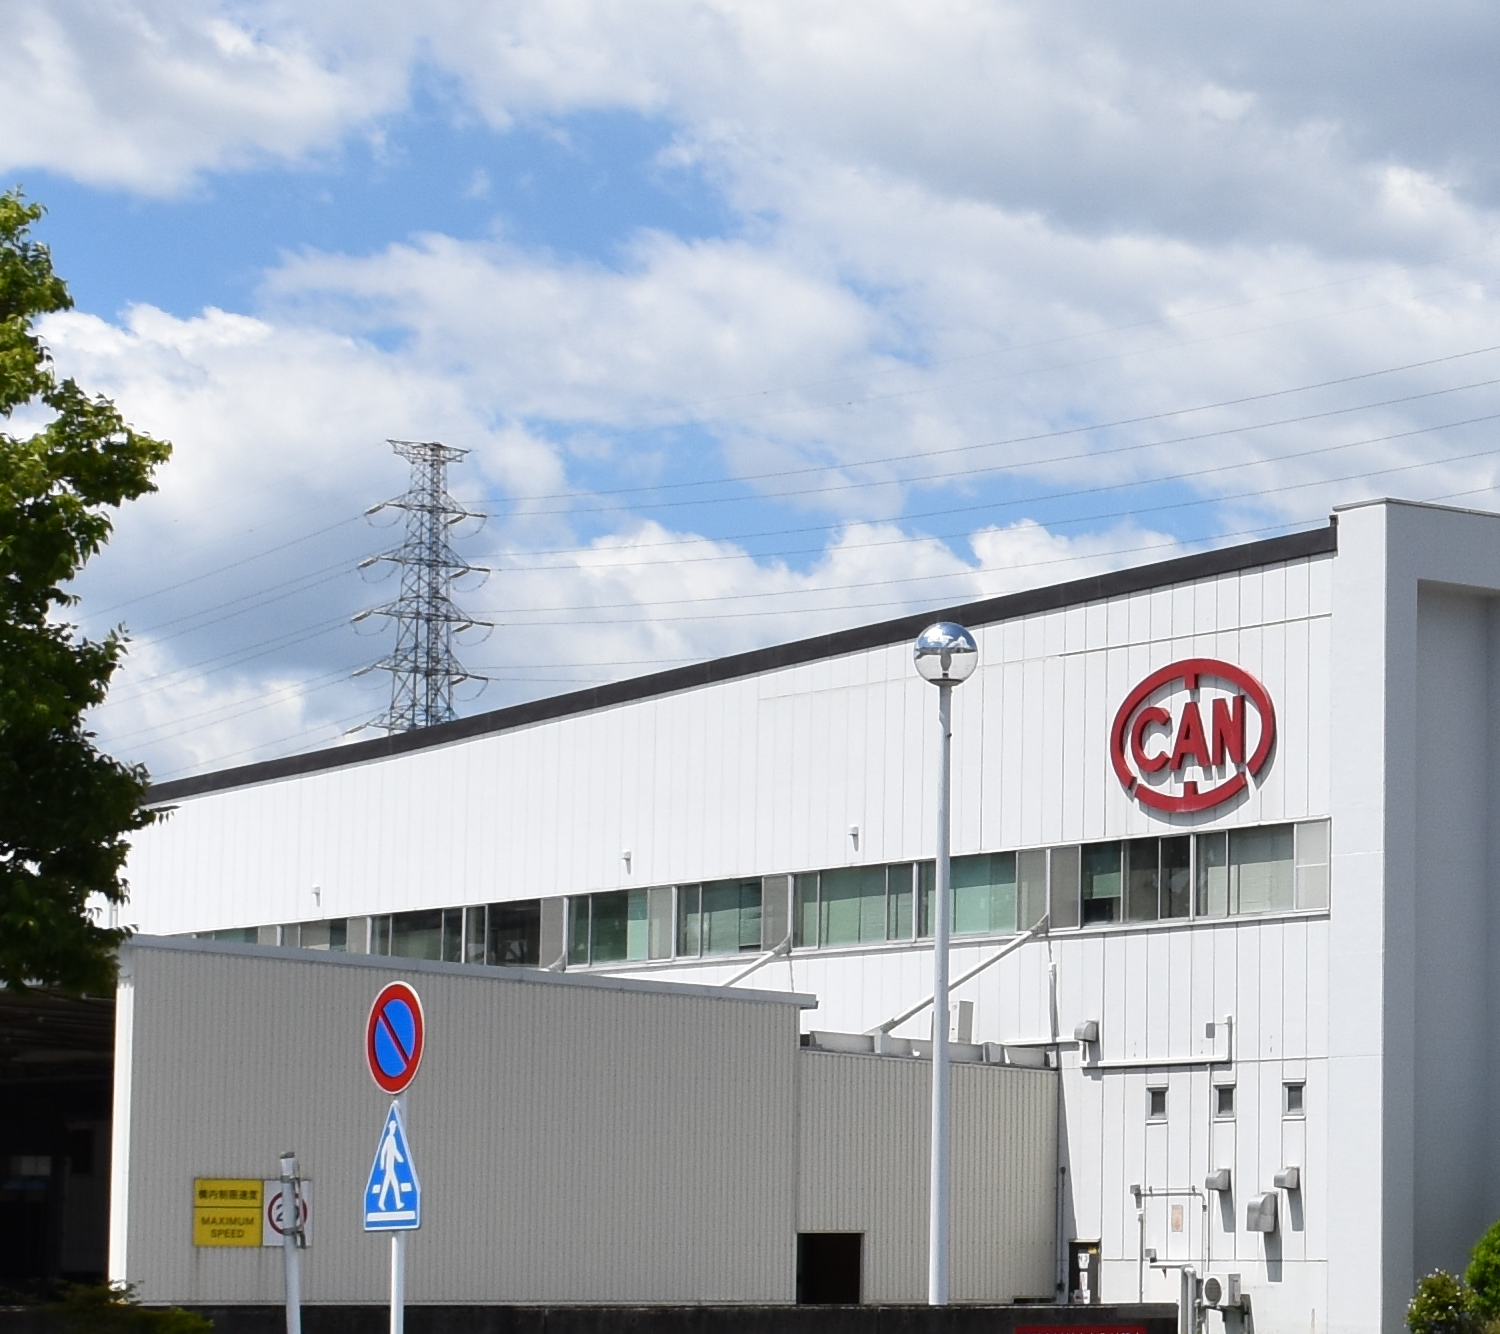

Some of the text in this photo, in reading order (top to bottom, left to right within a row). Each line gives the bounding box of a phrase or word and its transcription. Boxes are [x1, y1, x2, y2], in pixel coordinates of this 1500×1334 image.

[1130, 694, 1246, 773] CAN
[201, 1216, 255, 1227] MAXIMUM
[210, 1228, 245, 1239] SPEED
